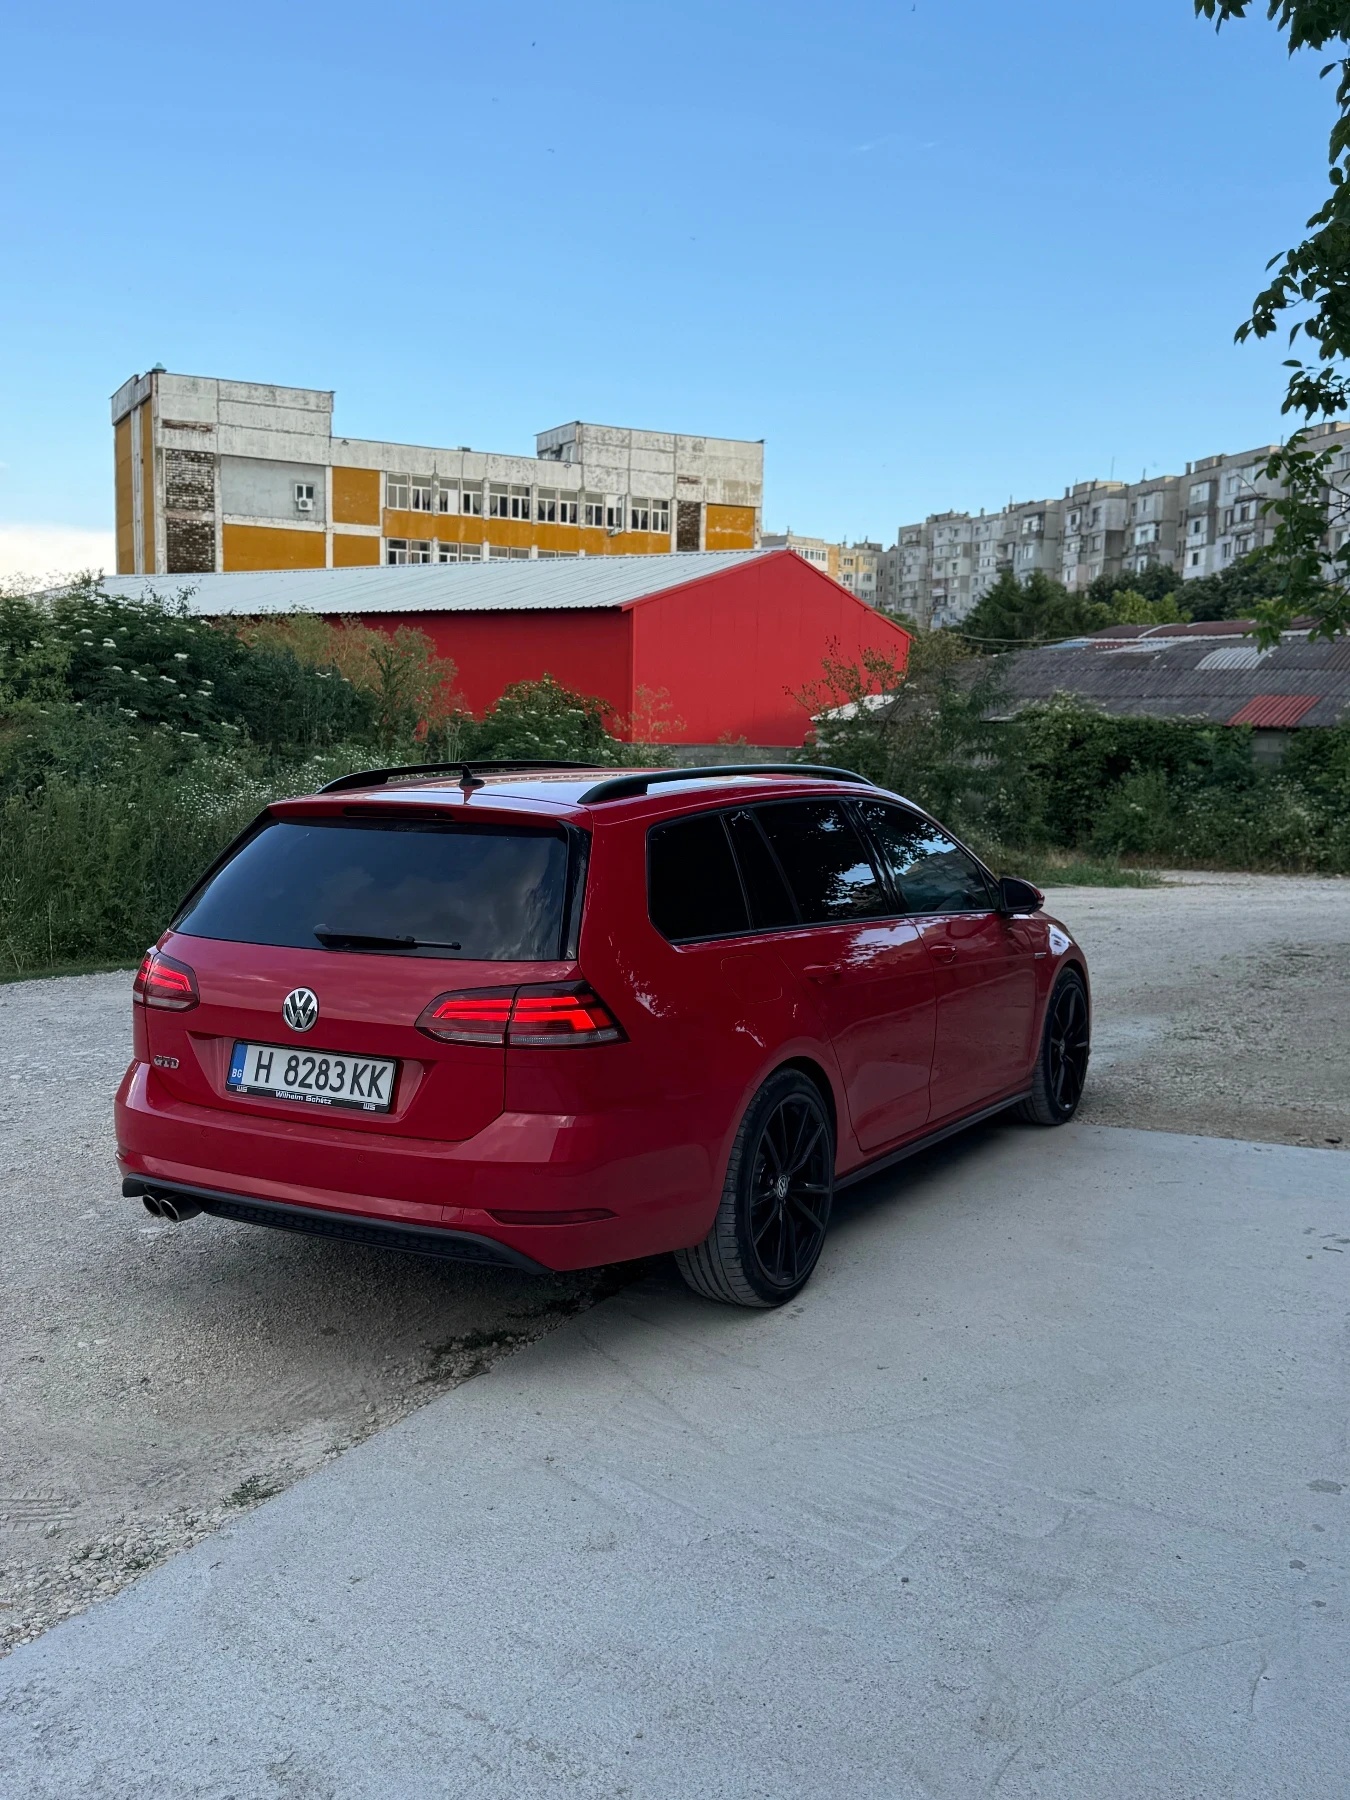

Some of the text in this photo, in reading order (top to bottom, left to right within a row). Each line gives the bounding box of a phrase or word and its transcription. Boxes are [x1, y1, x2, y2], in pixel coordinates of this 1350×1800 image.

[283, 987, 318, 1032] VW
[232, 1069, 243, 1078] BG
[254, 1051, 274, 1083] H
